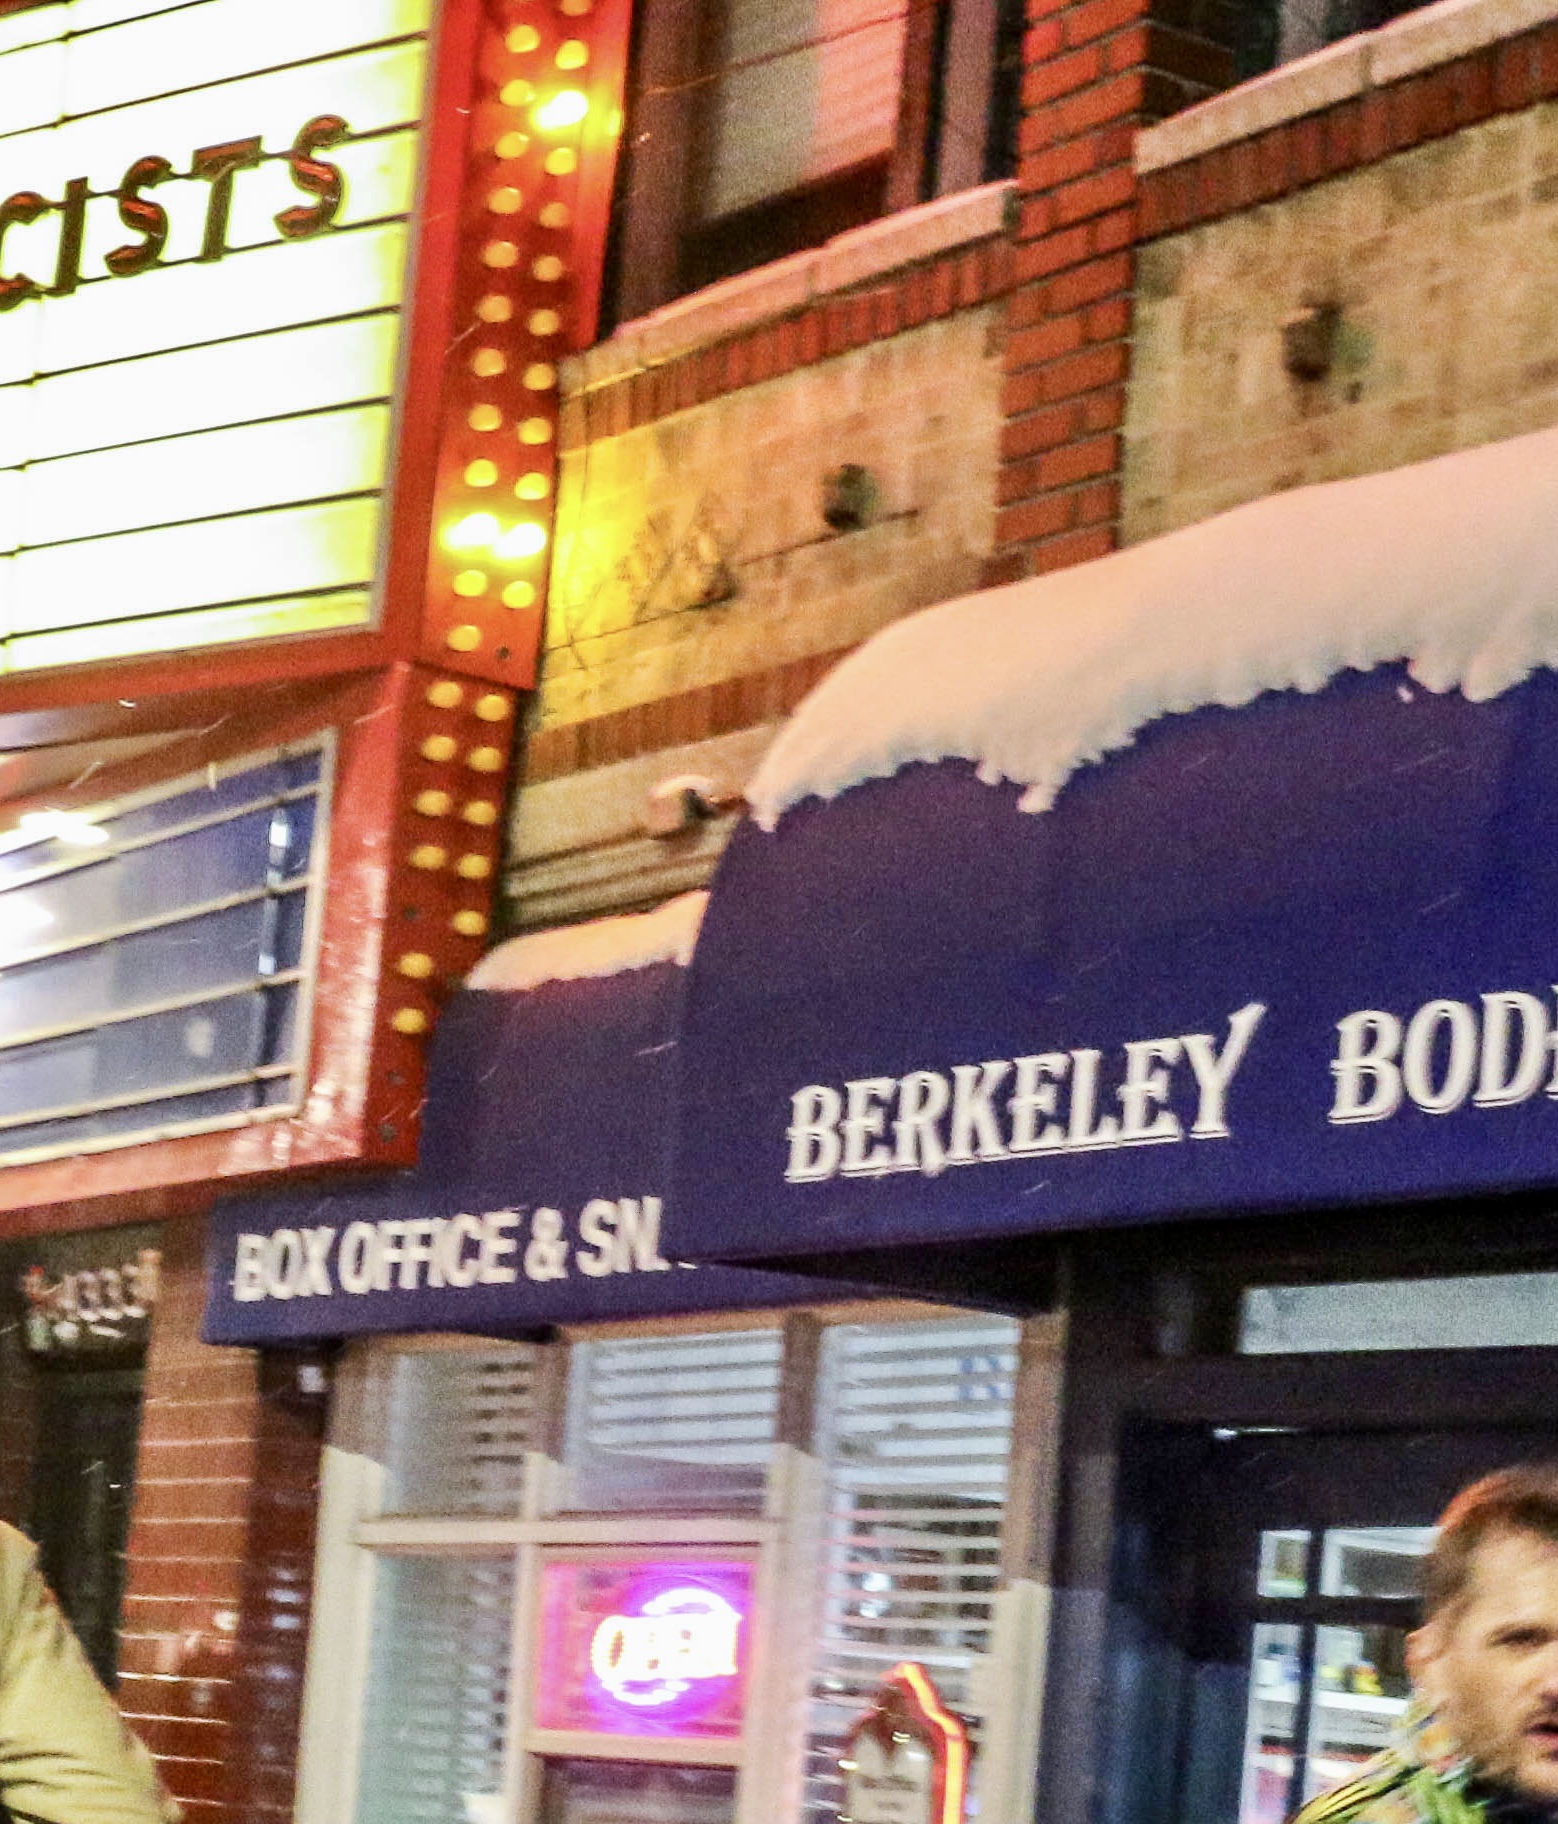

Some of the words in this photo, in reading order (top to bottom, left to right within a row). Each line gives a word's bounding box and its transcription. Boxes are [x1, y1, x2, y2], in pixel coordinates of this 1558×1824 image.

[783, 1002, 1268, 1184] BERKELEY
[232, 1225, 336, 1302] BOX
[337, 1211, 523, 1295] OFFICE
[524, 1207, 569, 1282] &
[576, 1196, 671, 1278] SN
[591, 1613, 740, 1682] OPEN
